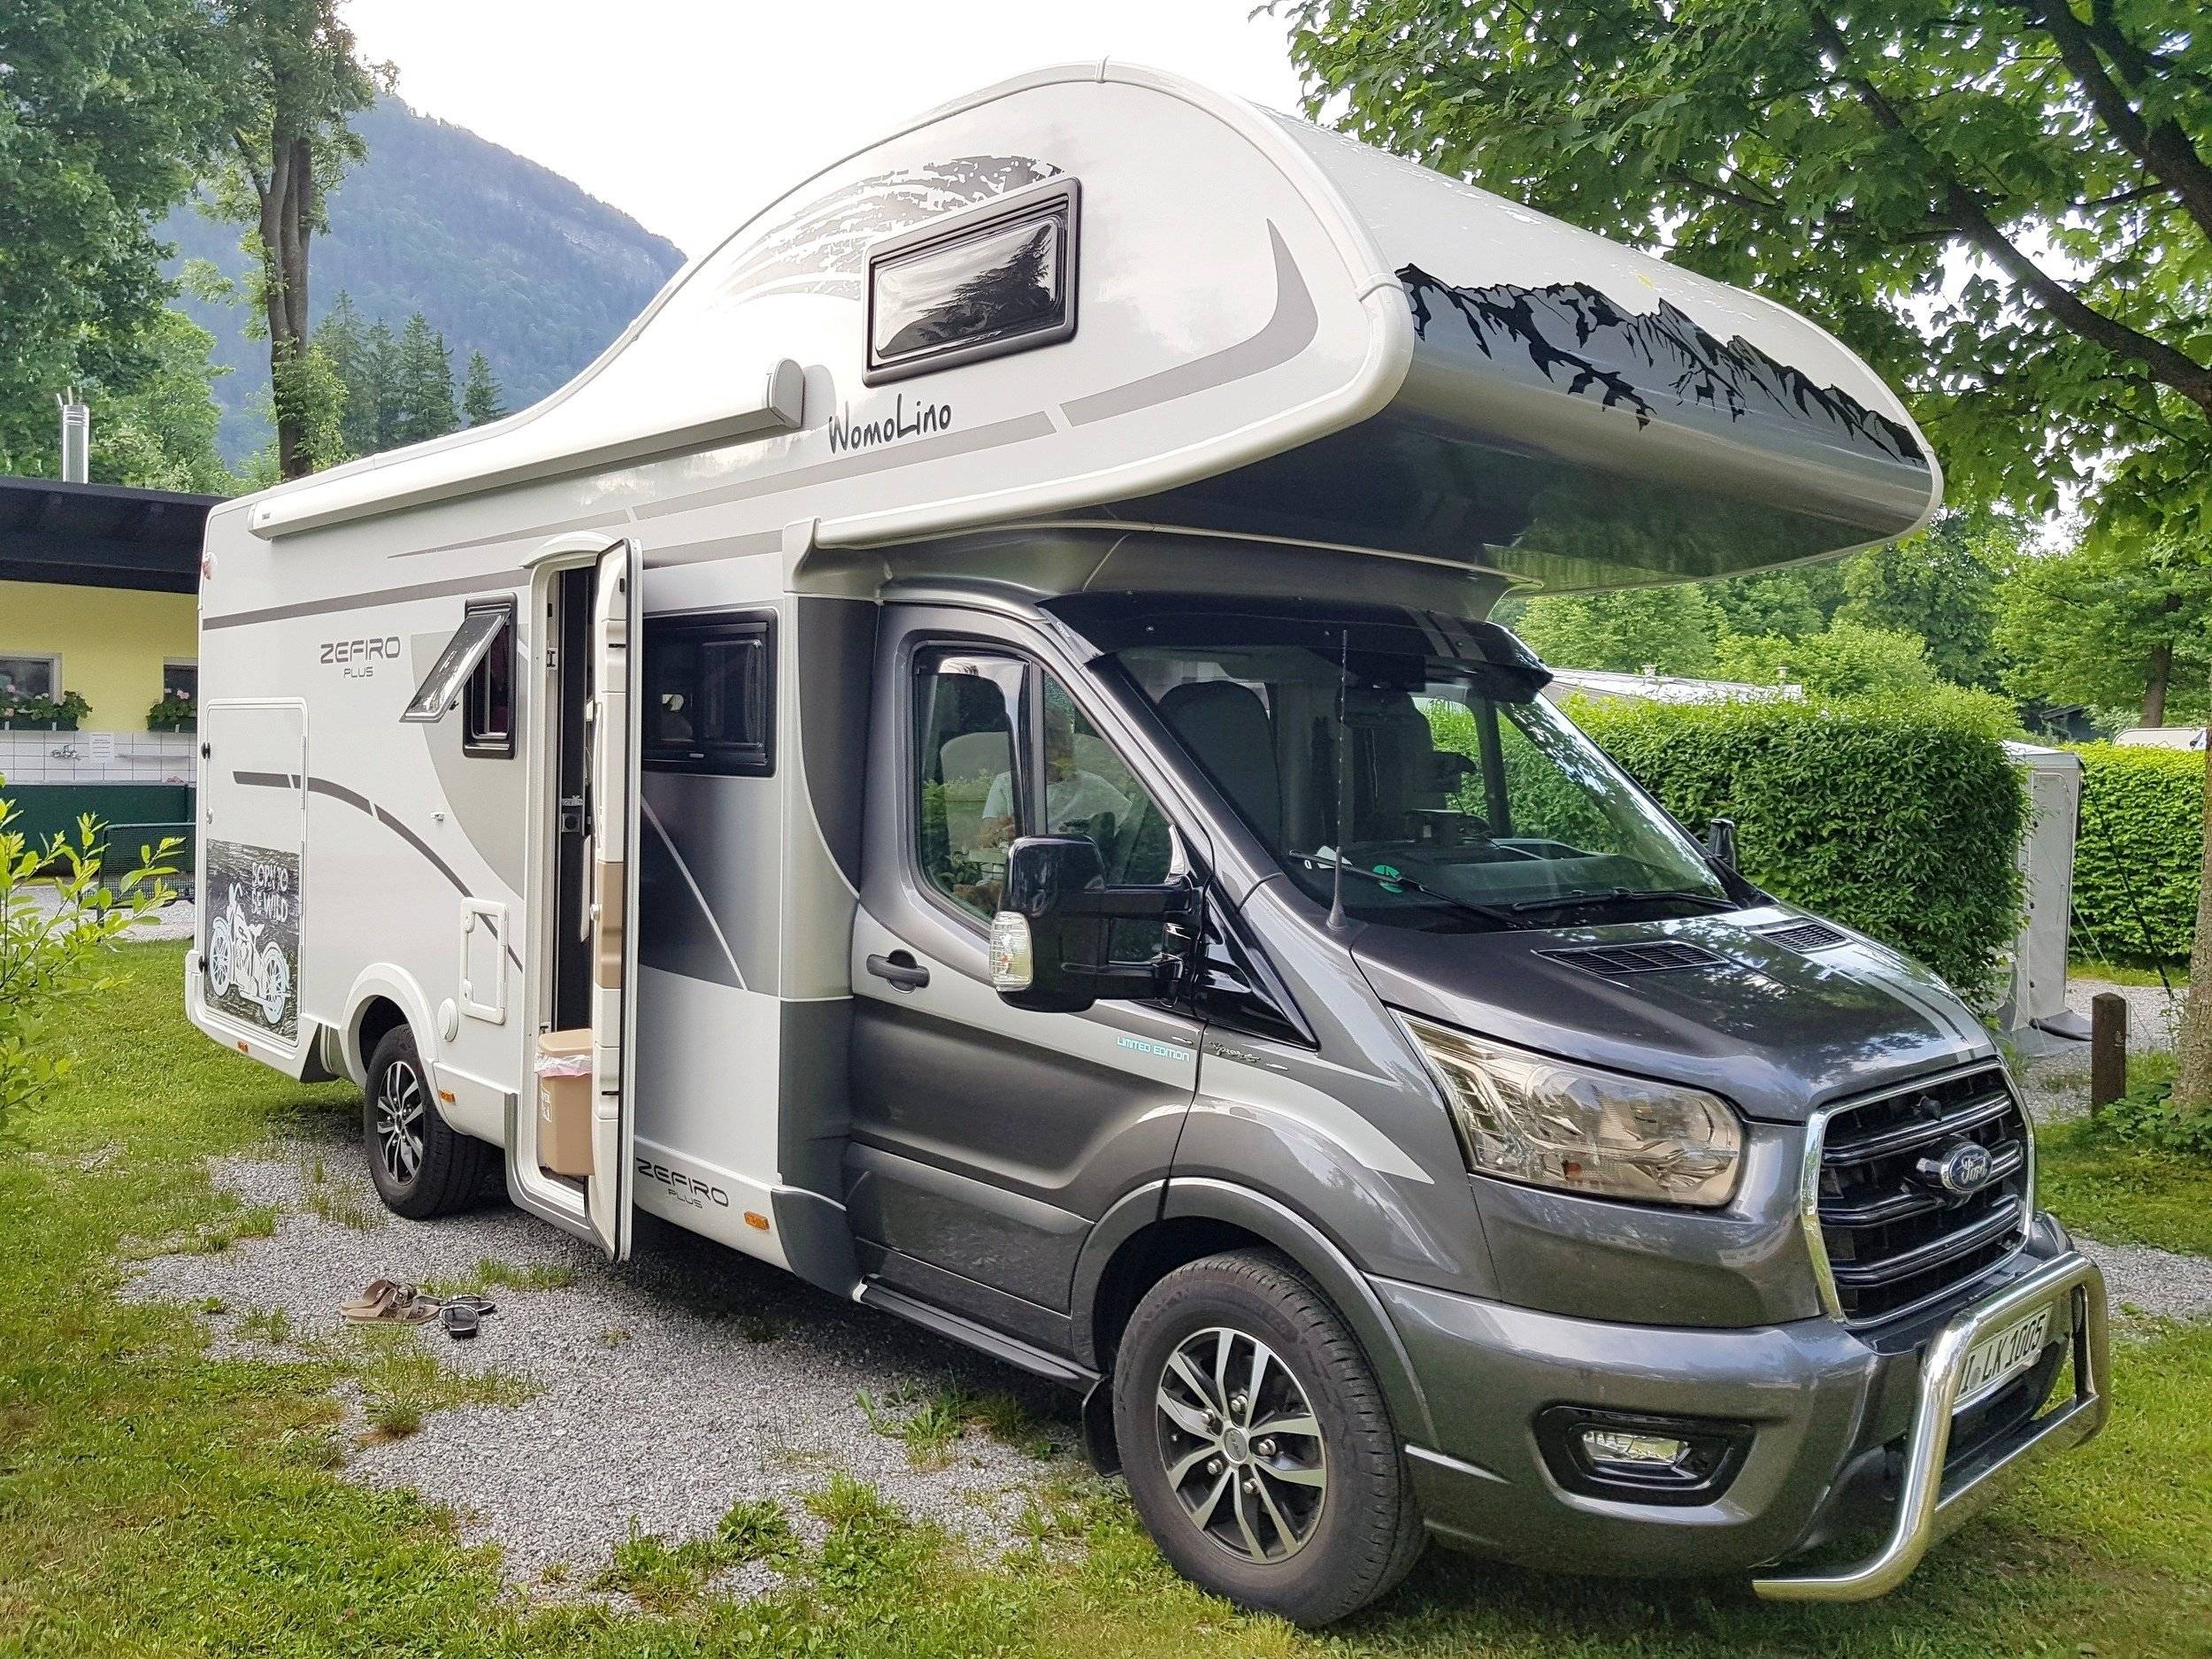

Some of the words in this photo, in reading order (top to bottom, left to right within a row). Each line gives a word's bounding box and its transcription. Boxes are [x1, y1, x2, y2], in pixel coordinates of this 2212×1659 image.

[828, 393, 952, 454] WomoLino
[320, 636, 401, 664] ZEFIRO
[343, 666, 373, 679] PLUS
[1117, 1036, 1151, 1053] LIMITED
[1153, 1046, 1190, 1062] EDITION
[636, 1157, 729, 1207] ZEFIRO
[668, 1188, 703, 1210] PLUS
[1981, 1335, 2008, 1383] LK
[2003, 1313, 2047, 1370] 1005
